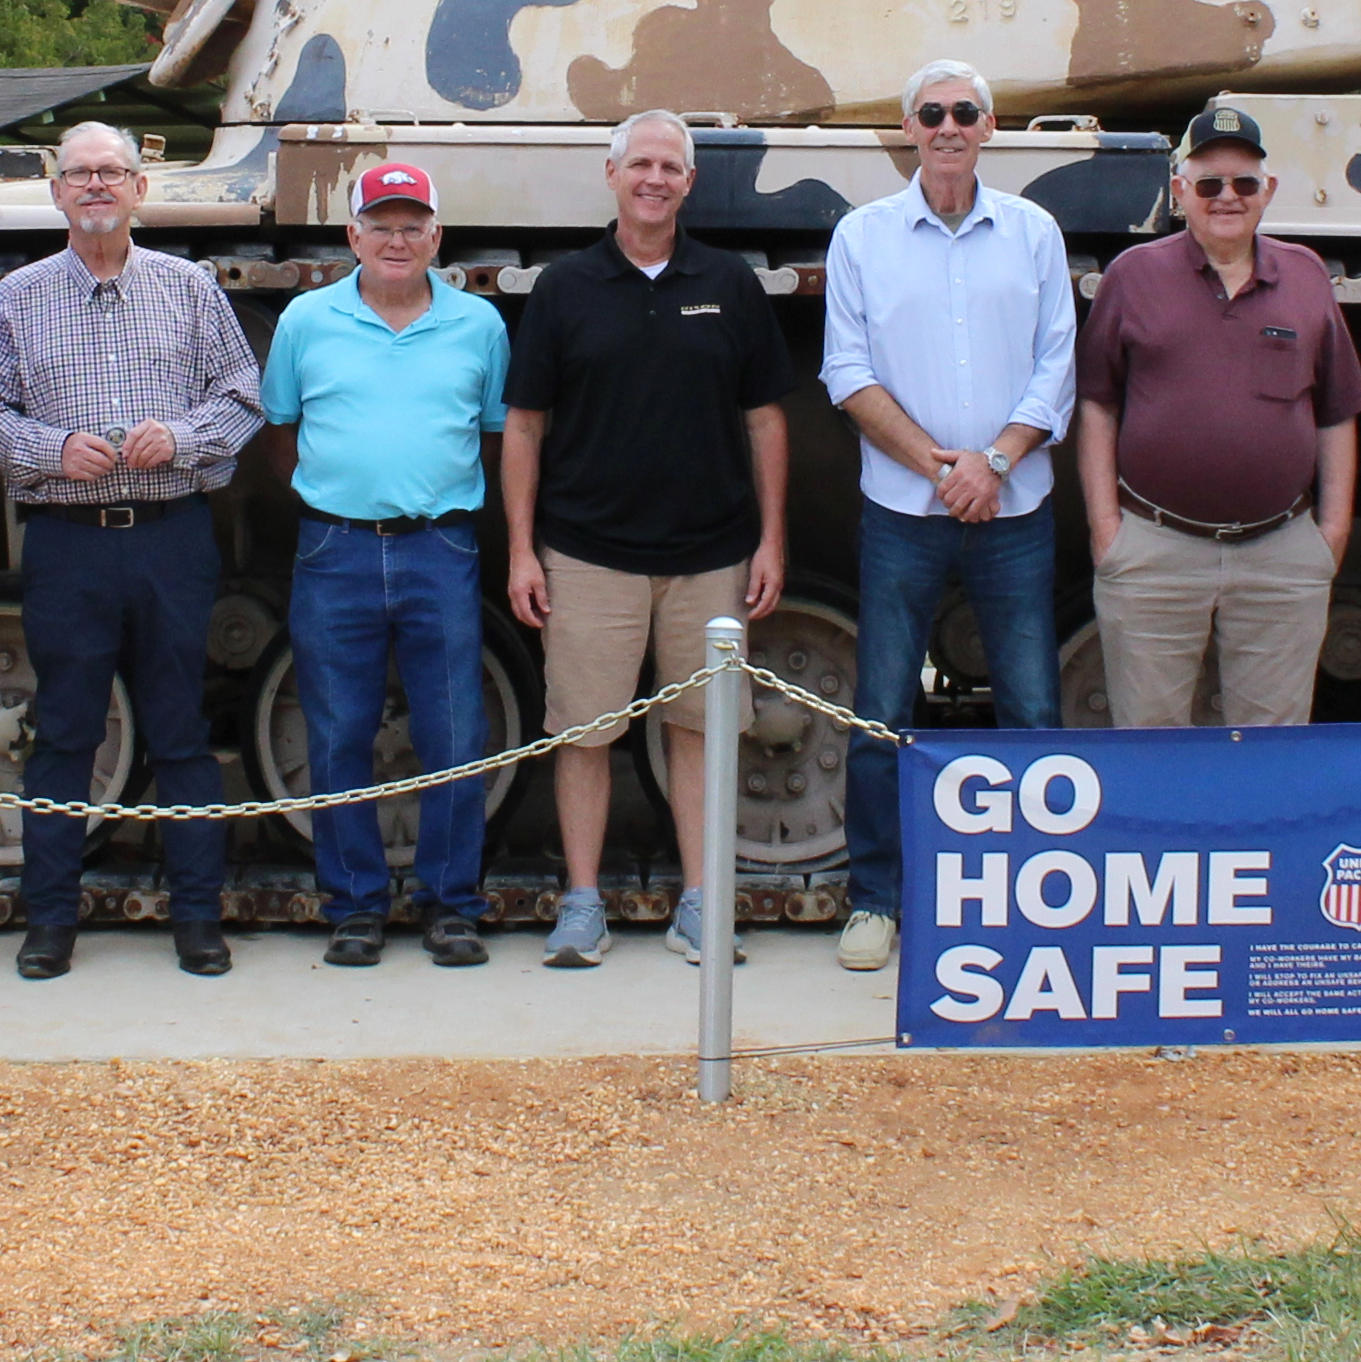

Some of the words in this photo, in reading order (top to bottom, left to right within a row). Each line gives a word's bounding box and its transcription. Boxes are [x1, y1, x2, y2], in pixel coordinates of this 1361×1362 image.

[933, 754, 1101, 836] GO
[936, 850, 1272, 929] HOME
[1255, 943, 1278, 951] HAVE
[1279, 943, 1296, 951] THE
[1297, 942, 1337, 951] COURAGE
[1338, 942, 1350, 950] TO
[1317, 954, 1339, 962] HAVE
[1273, 961, 1294, 969] HAVE
[1274, 972, 1296, 980] STOP
[930, 945, 1223, 1022] SAFE
[1248, 979, 1260, 987] OR
[1262, 979, 1299, 987] ADDRESS
[1253, 990, 1271, 998] WILL
[1274, 990, 1304, 998] ACCEPT
[1323, 989, 1345, 997] SAME
[1247, 1008, 1261, 1016] WE
[1262, 1008, 1283, 1016] WILL
[1283, 1008, 1299, 1016] ALL
[1300, 1008, 1313, 1016] GO
[1314, 1007, 1340, 1016] HOME
